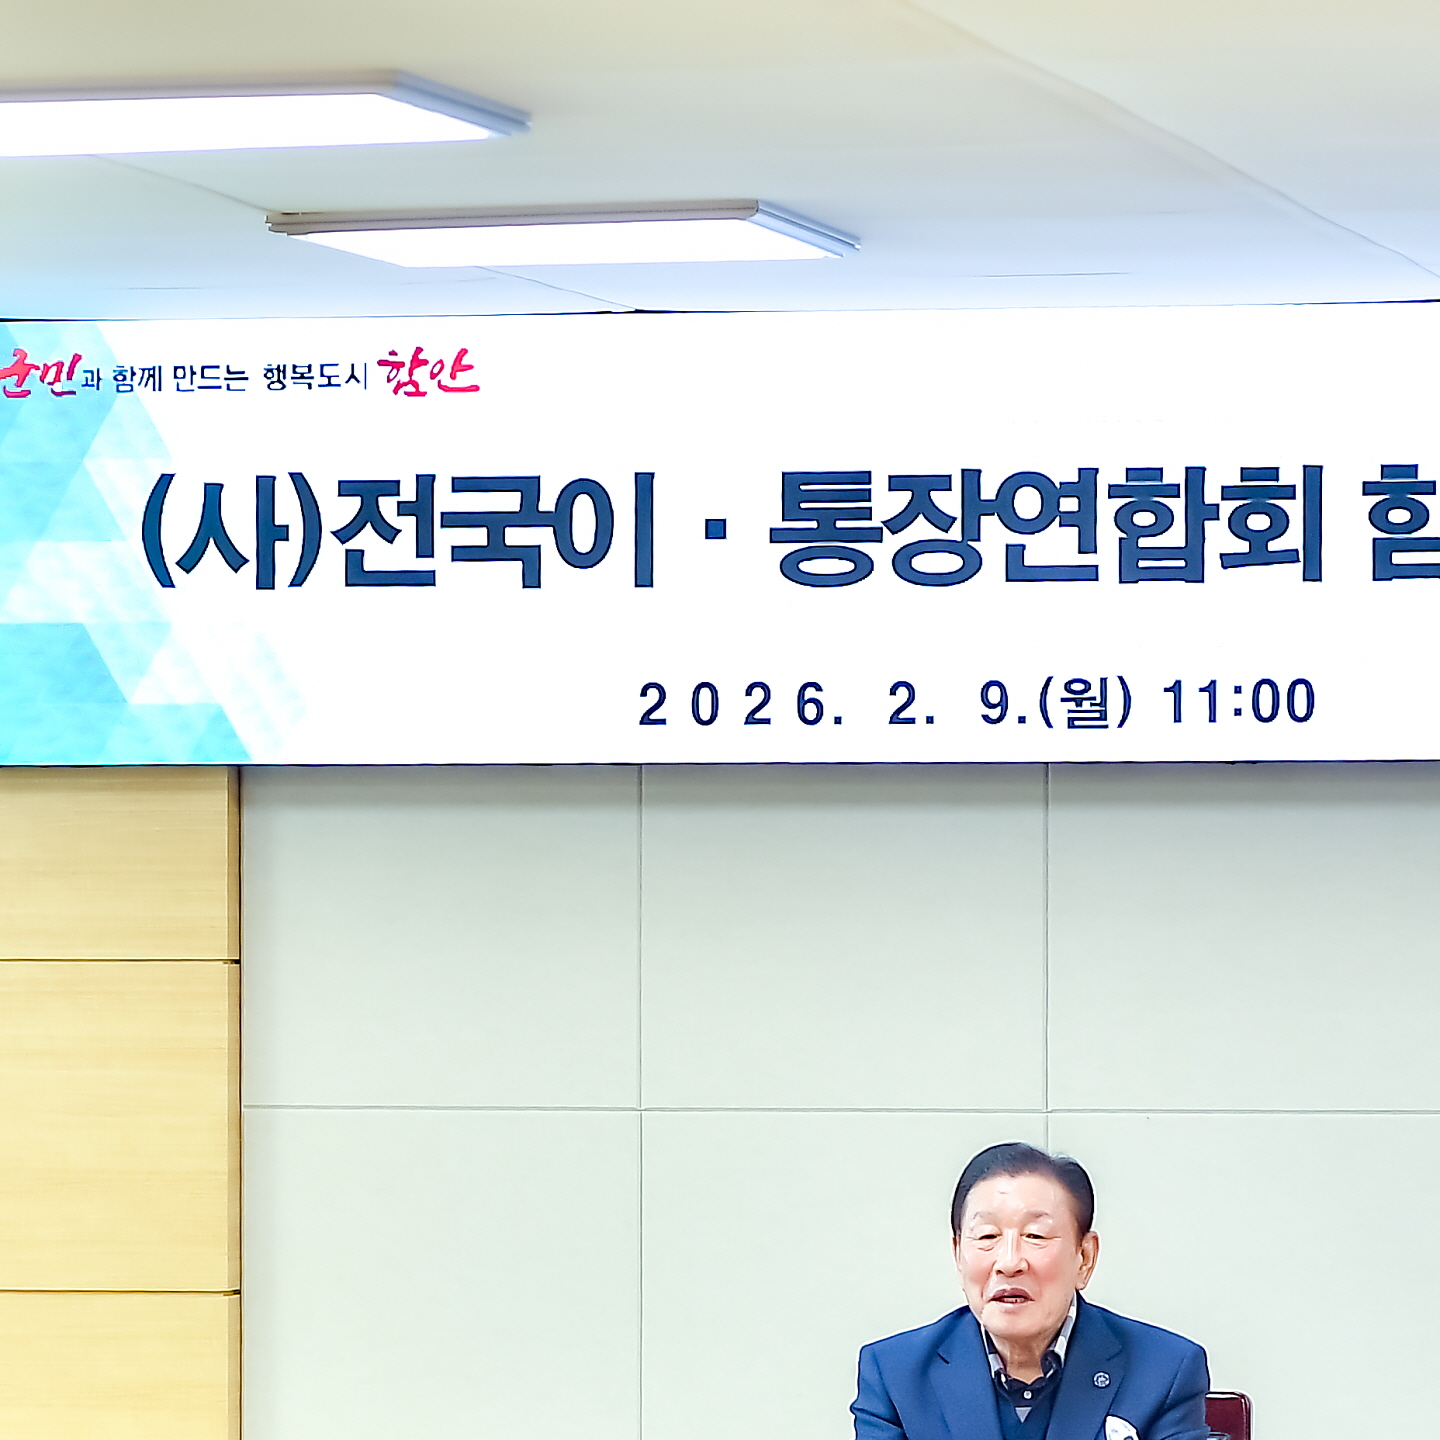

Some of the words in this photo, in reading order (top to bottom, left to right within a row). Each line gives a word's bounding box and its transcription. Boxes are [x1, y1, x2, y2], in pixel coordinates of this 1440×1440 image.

[112, 364, 162, 393] 함께
[173, 364, 249, 392] 만드는
[263, 362, 367, 391] 행복도시
[376, 346, 480, 397] 함안
[141, 471, 656, 591] (사)전국이
[769, 464, 1324, 588] 통장연합회
[888, 680, 936, 726] 2.
[980, 674, 1133, 730] 9.(월)
[1162, 677, 1316, 725] 11:00
